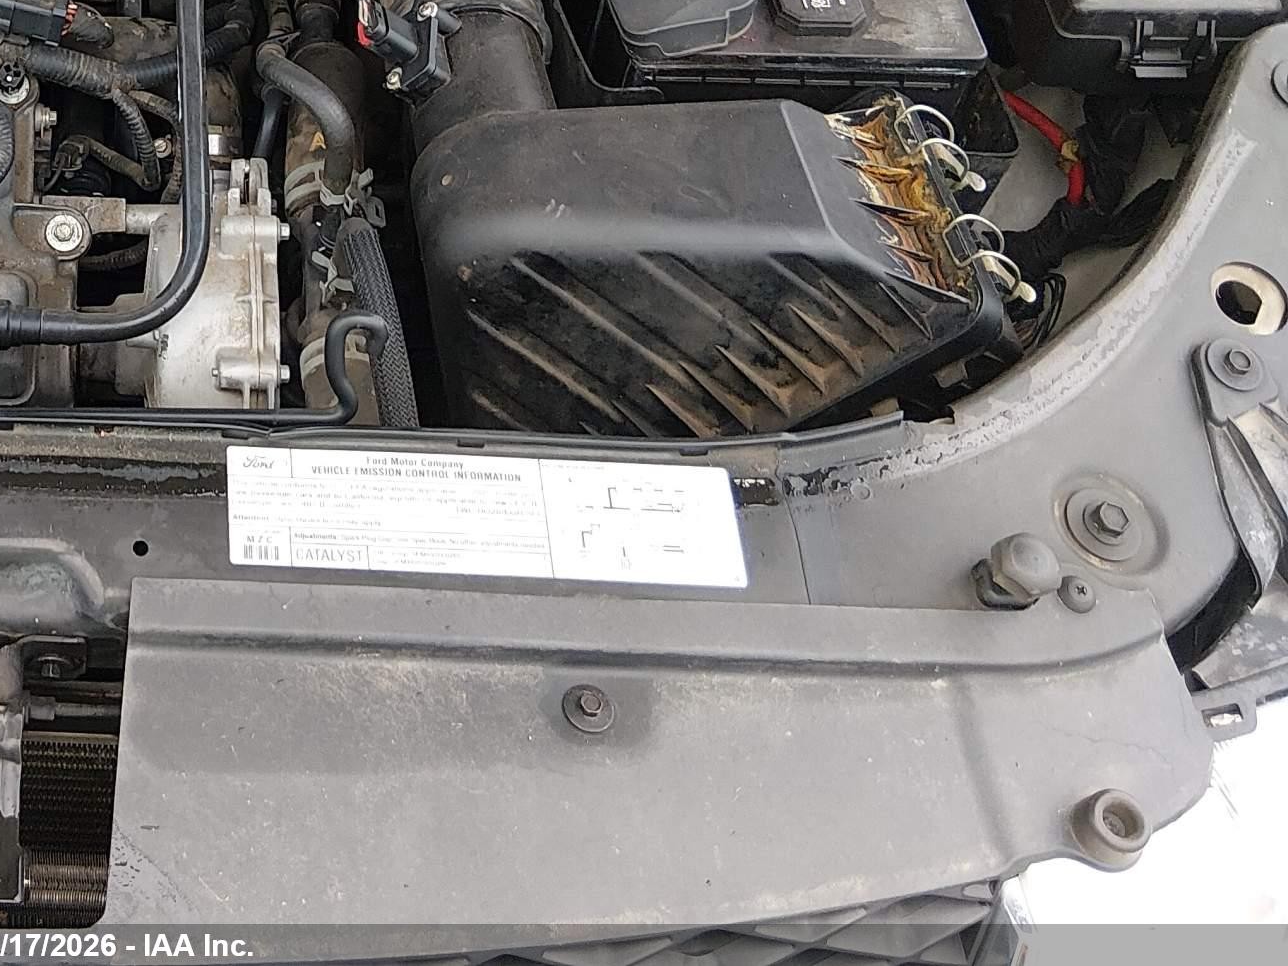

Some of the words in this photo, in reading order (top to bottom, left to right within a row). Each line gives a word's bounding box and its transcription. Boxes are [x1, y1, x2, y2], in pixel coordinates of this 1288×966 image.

[242, 454, 274, 469] Ford
[366, 457, 387, 466] Ford
[391, 457, 418, 467] Motor
[420, 458, 464, 470] Company
[311, 466, 350, 475] VEHICLE
[354, 467, 402, 477] EMISSION
[405, 468, 450, 479] CONTROL
[454, 471, 522, 482] INFORMATION
[295, 548, 363, 563] CATALYST
